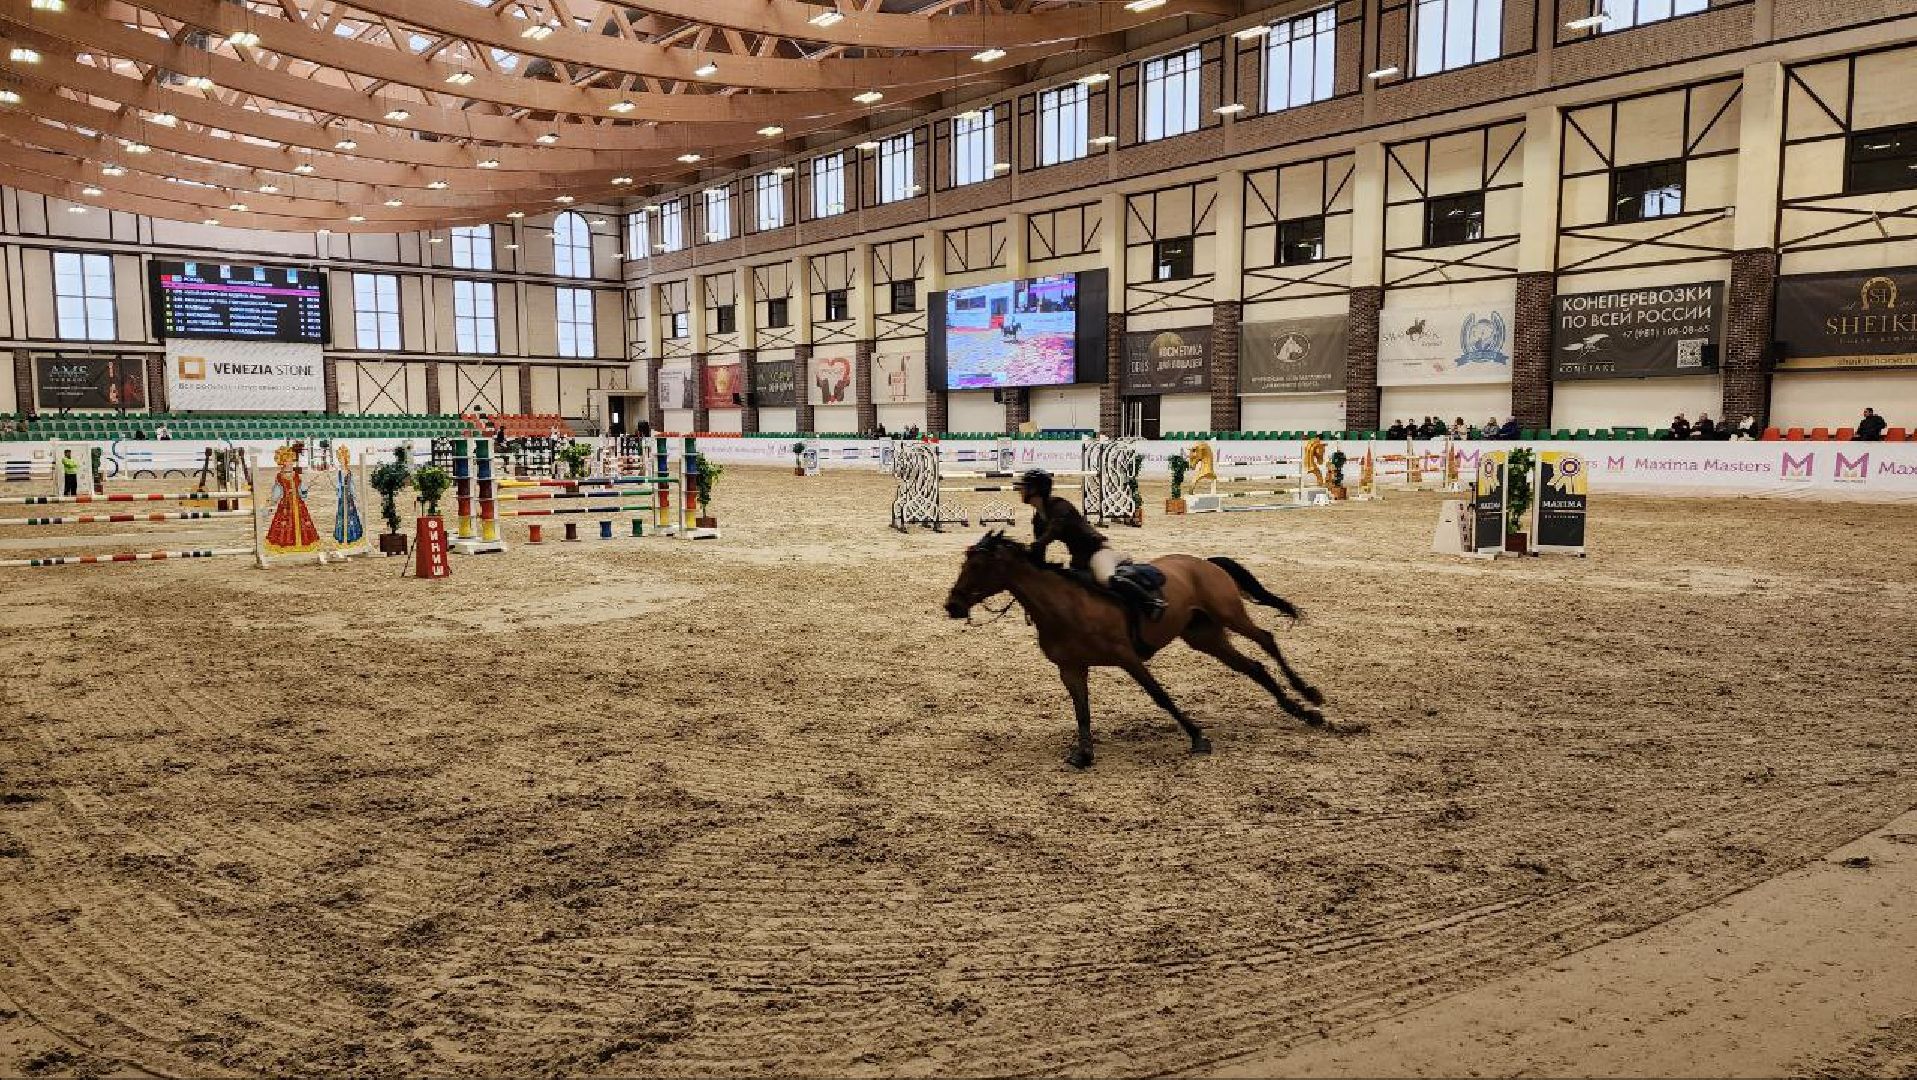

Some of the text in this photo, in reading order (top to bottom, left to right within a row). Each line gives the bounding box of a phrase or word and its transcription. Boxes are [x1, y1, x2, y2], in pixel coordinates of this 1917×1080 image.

[1562, 286, 1712, 312] КОНЕПЕРЕВОЗКИ
[1562, 305, 1712, 329] ПО ВСЕЙ РОССИИ
[213, 362, 315, 376] VENEZIA STONE
[1607, 455, 1625, 471] M
[1635, 458, 1698, 472] Maxima
[1703, 458, 1771, 472] Masters
[1781, 452, 1815, 477] M
[1833, 452, 1870, 478] M
[428, 520, 444, 576] ФИНИШ
